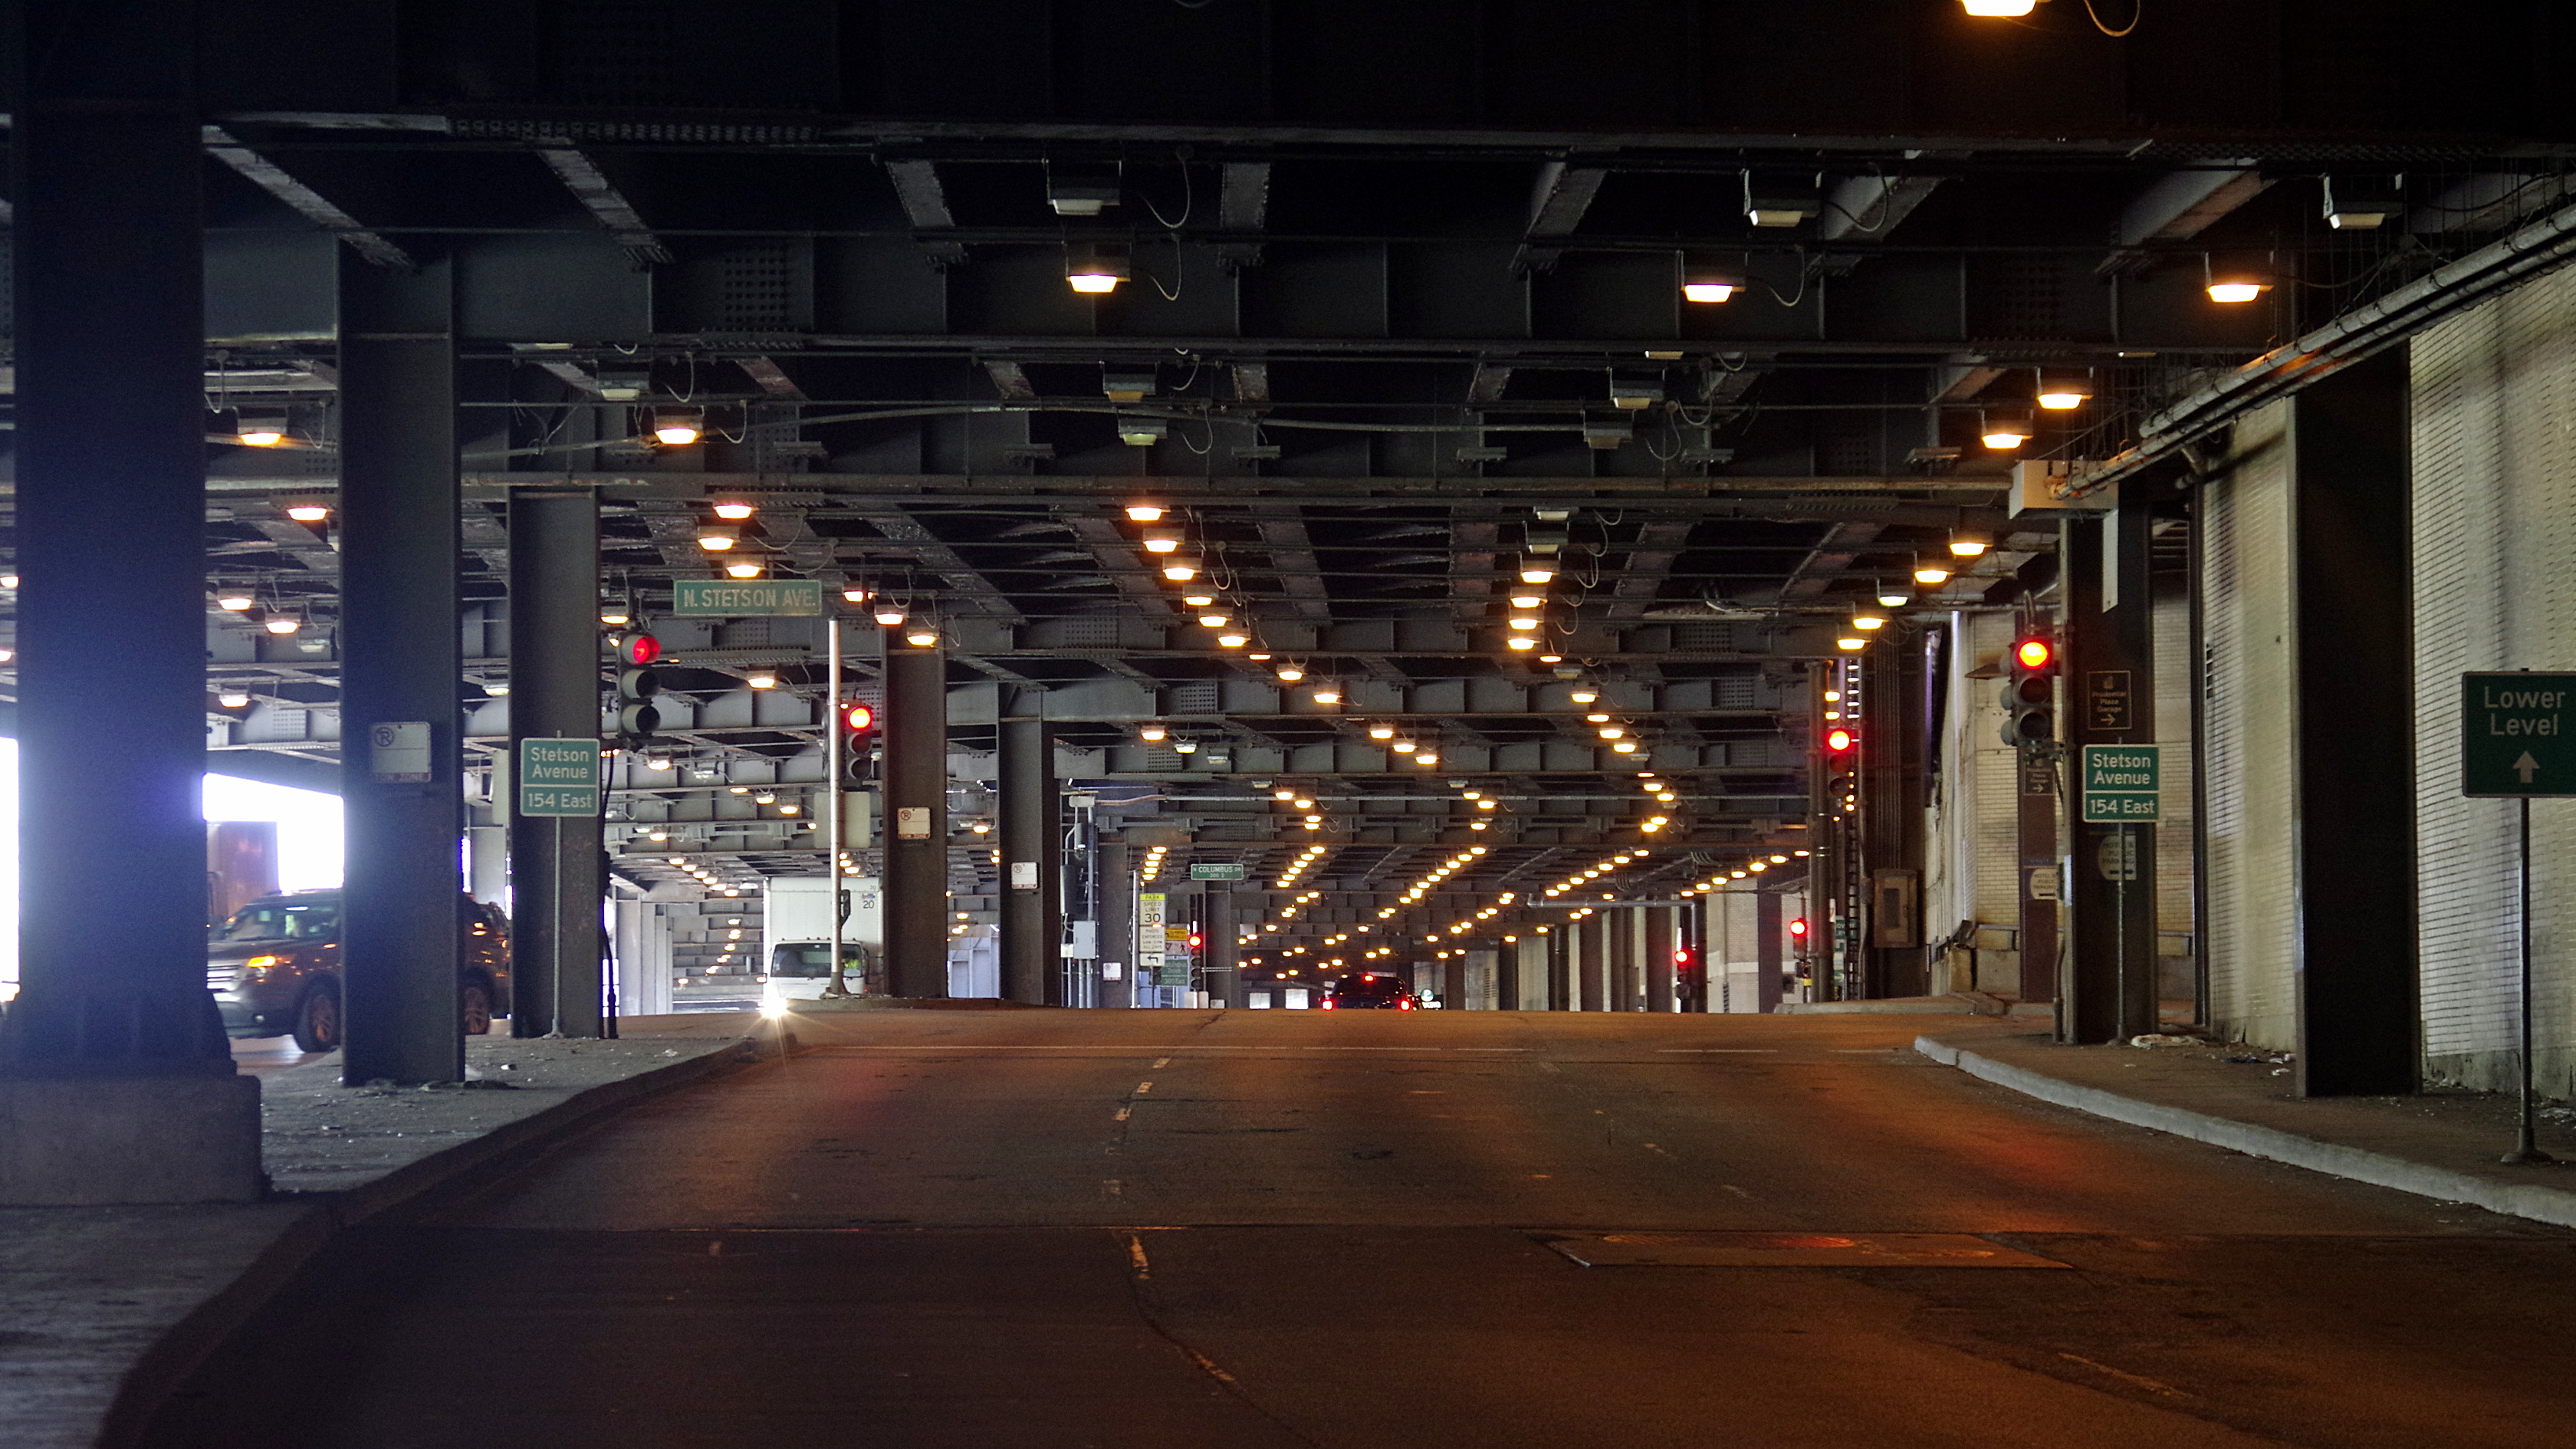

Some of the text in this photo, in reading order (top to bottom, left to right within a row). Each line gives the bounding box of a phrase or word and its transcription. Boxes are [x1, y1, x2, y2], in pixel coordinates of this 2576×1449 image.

[683, 589, 816, 607] N. STETSON AVE.
[2484, 686, 2565, 708] Lower
[2490, 713, 2558, 736] Level
[531, 747, 589, 762] Stetson
[2092, 753, 2150, 768] Stetson
[532, 764, 588, 779] Avenue
[2094, 770, 2150, 785] Avenue
[527, 793, 592, 808] 154 East
[2090, 799, 2155, 814] 154 East
[863, 900, 875, 909] 20
[1145, 913, 1162, 923] 30
